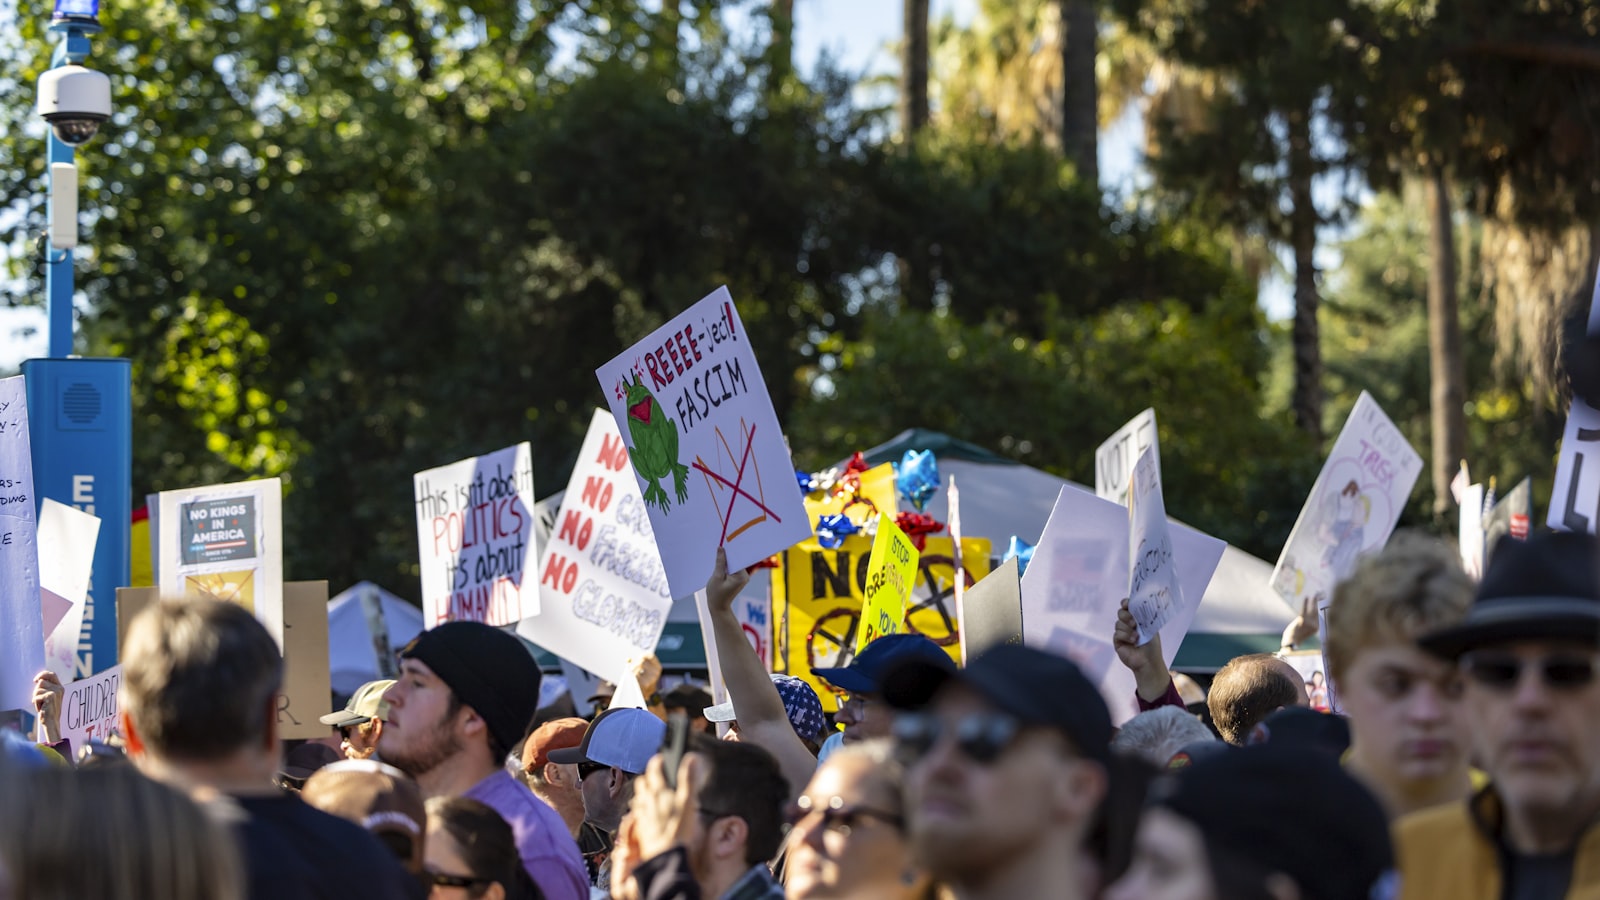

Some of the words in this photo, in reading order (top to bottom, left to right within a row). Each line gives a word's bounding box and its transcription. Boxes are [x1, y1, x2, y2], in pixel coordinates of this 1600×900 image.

[675, 356, 748, 434] FASCIM
[596, 432, 628, 472] NO
[415, 478, 449, 521] this
[488, 456, 532, 501] about
[582, 476, 613, 513] NO
[190, 509, 208, 520] NO
[210, 504, 247, 518] KINGS
[212, 518, 225, 530] IN
[433, 495, 524, 557] POLITICS
[559, 509, 593, 551] NO
[191, 528, 245, 544] AMERICA
[891, 535, 910, 567] STOP
[475, 532, 525, 585] about
[541, 552, 579, 595] NO
